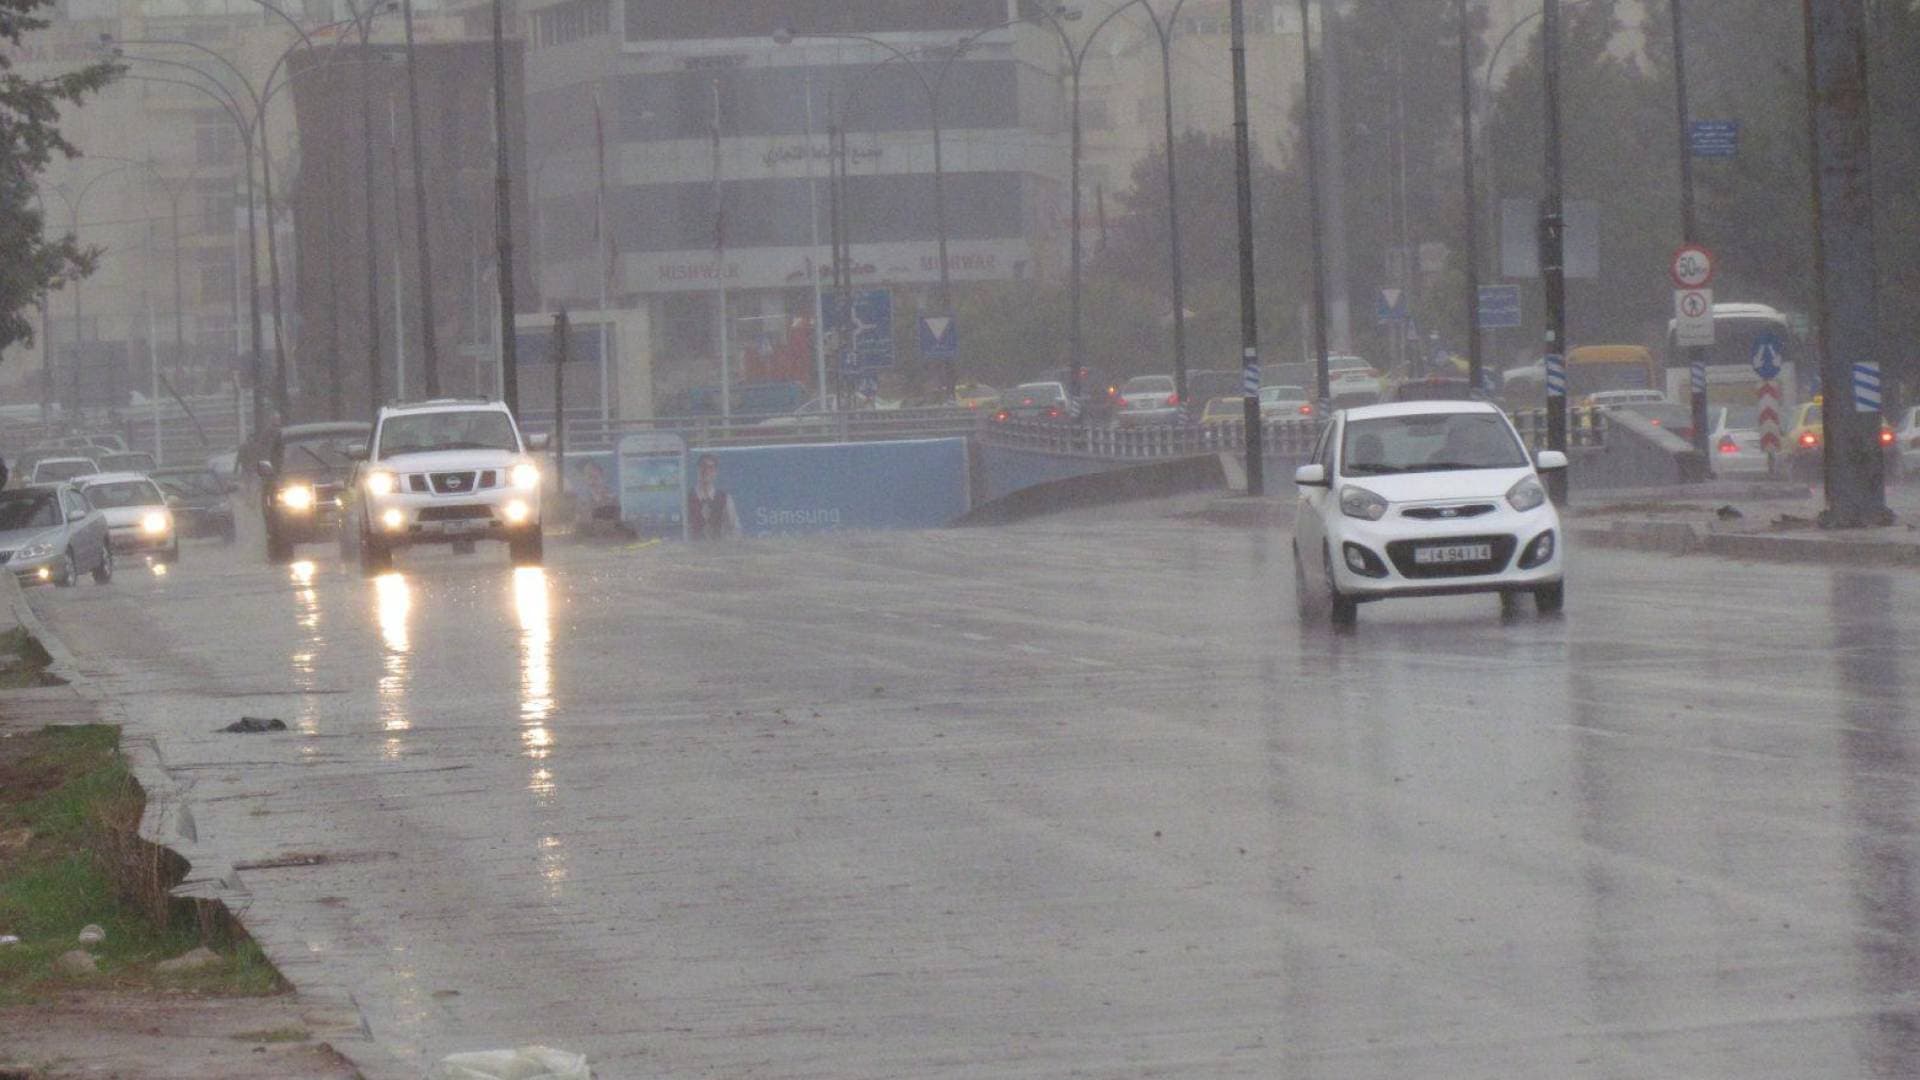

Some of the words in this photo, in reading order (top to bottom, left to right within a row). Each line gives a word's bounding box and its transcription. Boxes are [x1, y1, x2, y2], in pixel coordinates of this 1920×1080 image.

[919, 253, 996, 273] MIHWAR
[1679, 256, 1697, 277] 50
[756, 506, 841, 529] Samsung
